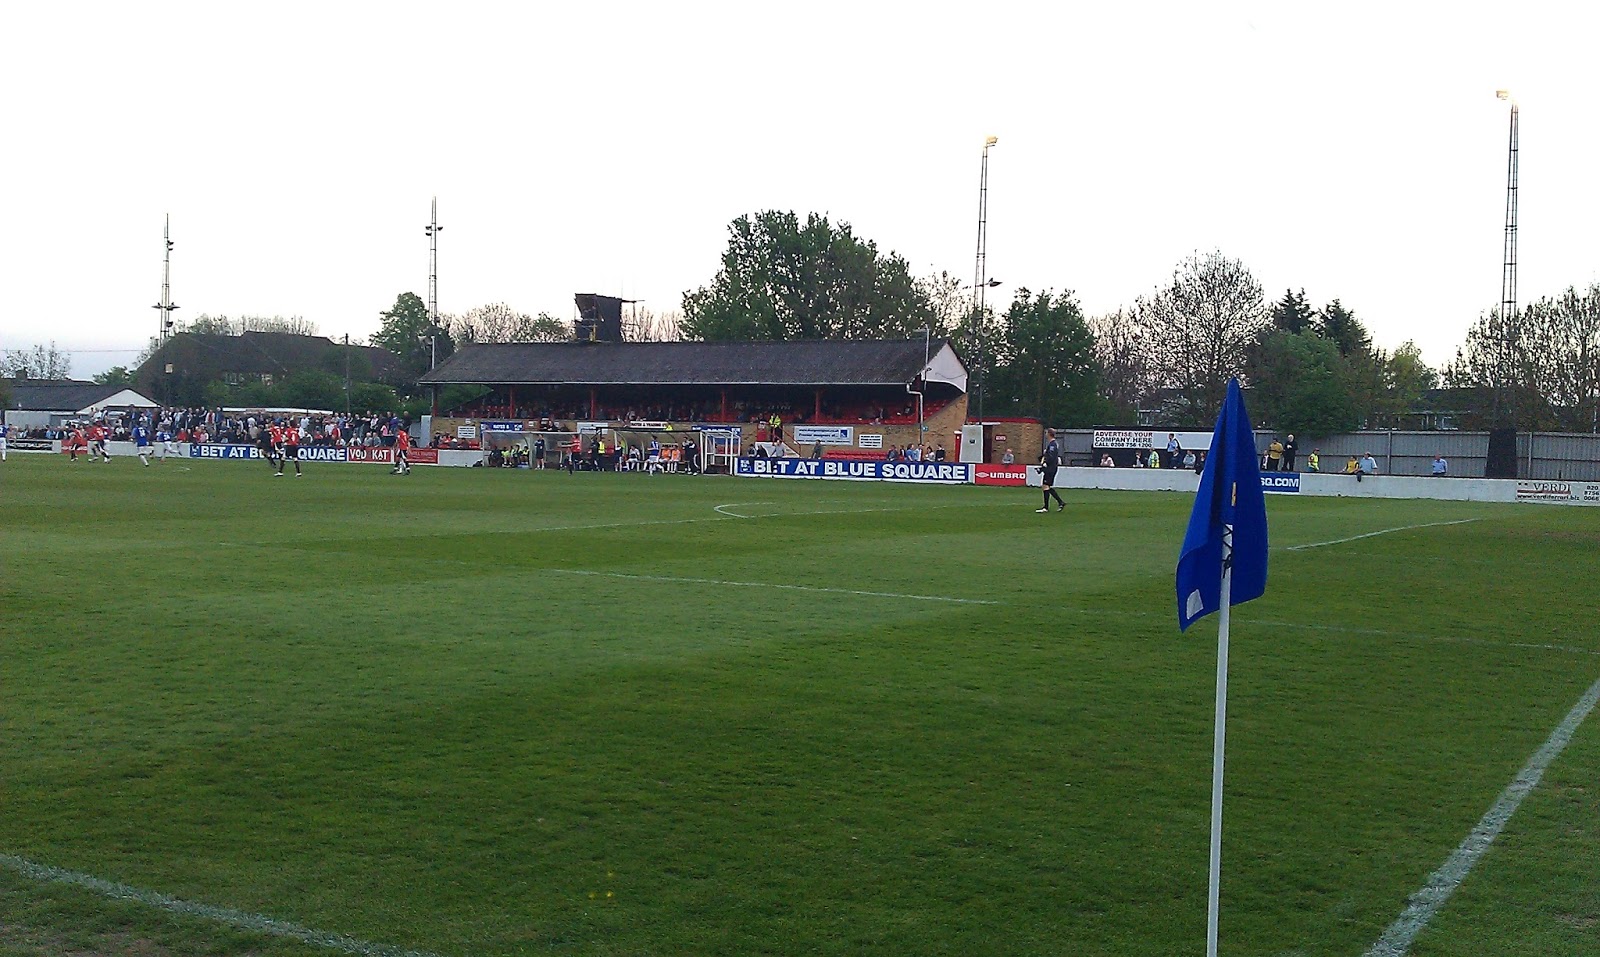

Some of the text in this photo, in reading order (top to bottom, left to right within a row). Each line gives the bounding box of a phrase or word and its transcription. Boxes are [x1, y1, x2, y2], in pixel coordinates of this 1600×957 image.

[201, 446, 226, 457] BET
[229, 446, 247, 458] AT
[297, 448, 346, 460] QUARE
[794, 461, 819, 475] AT
[824, 462, 876, 477] BLUE
[881, 463, 966, 480] SQUARE
[1533, 483, 1571, 492] VERDI
